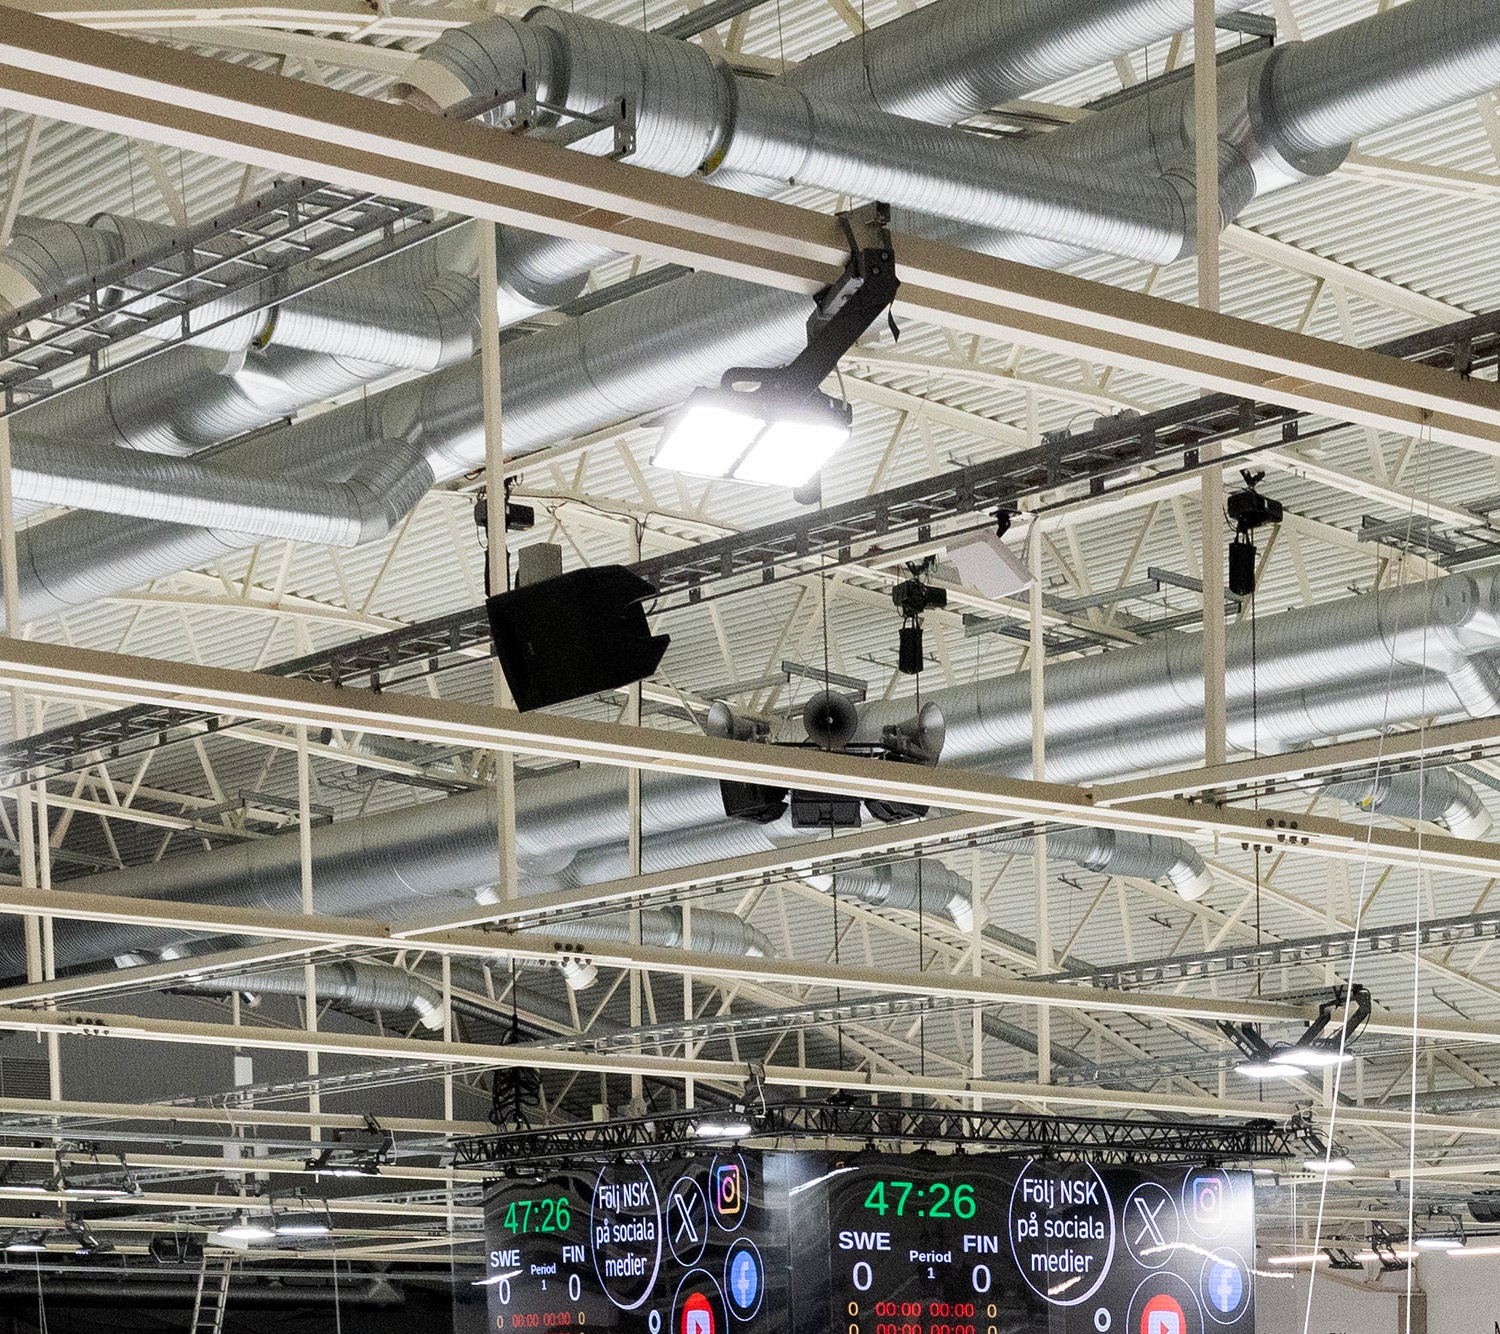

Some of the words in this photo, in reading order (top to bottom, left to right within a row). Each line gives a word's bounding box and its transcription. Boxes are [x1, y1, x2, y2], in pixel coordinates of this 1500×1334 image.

[599, 1185, 620, 1214] Följ
[623, 1182, 650, 1207] NSK
[864, 1181, 976, 1219] 47:26
[1023, 1178, 1054, 1208] Följ
[1060, 1180, 1098, 1206] NSK
[503, 1197, 571, 1234] 47:26
[1017, 1215, 1039, 1240] på
[1044, 1215, 1105, 1240] sociala
[596, 1218, 610, 1249] på
[612, 1218, 655, 1243] sociala
[838, 1231, 891, 1251] SWE
[963, 1235, 999, 1254] FIN
[490, 1250, 521, 1267] SWE
[562, 1245, 585, 1263] FIN
[605, 1255, 647, 1277] medier
[909, 1249, 952, 1264] Period
[1031, 1251, 1093, 1273] medier
[530, 1263, 557, 1276] Period
[852, 1261, 873, 1291] 0
[926, 1267, 935, 1280] 1
[971, 1264, 992, 1293] 0
[541, 1279, 547, 1291] 1
[568, 1273, 581, 1301] 0
